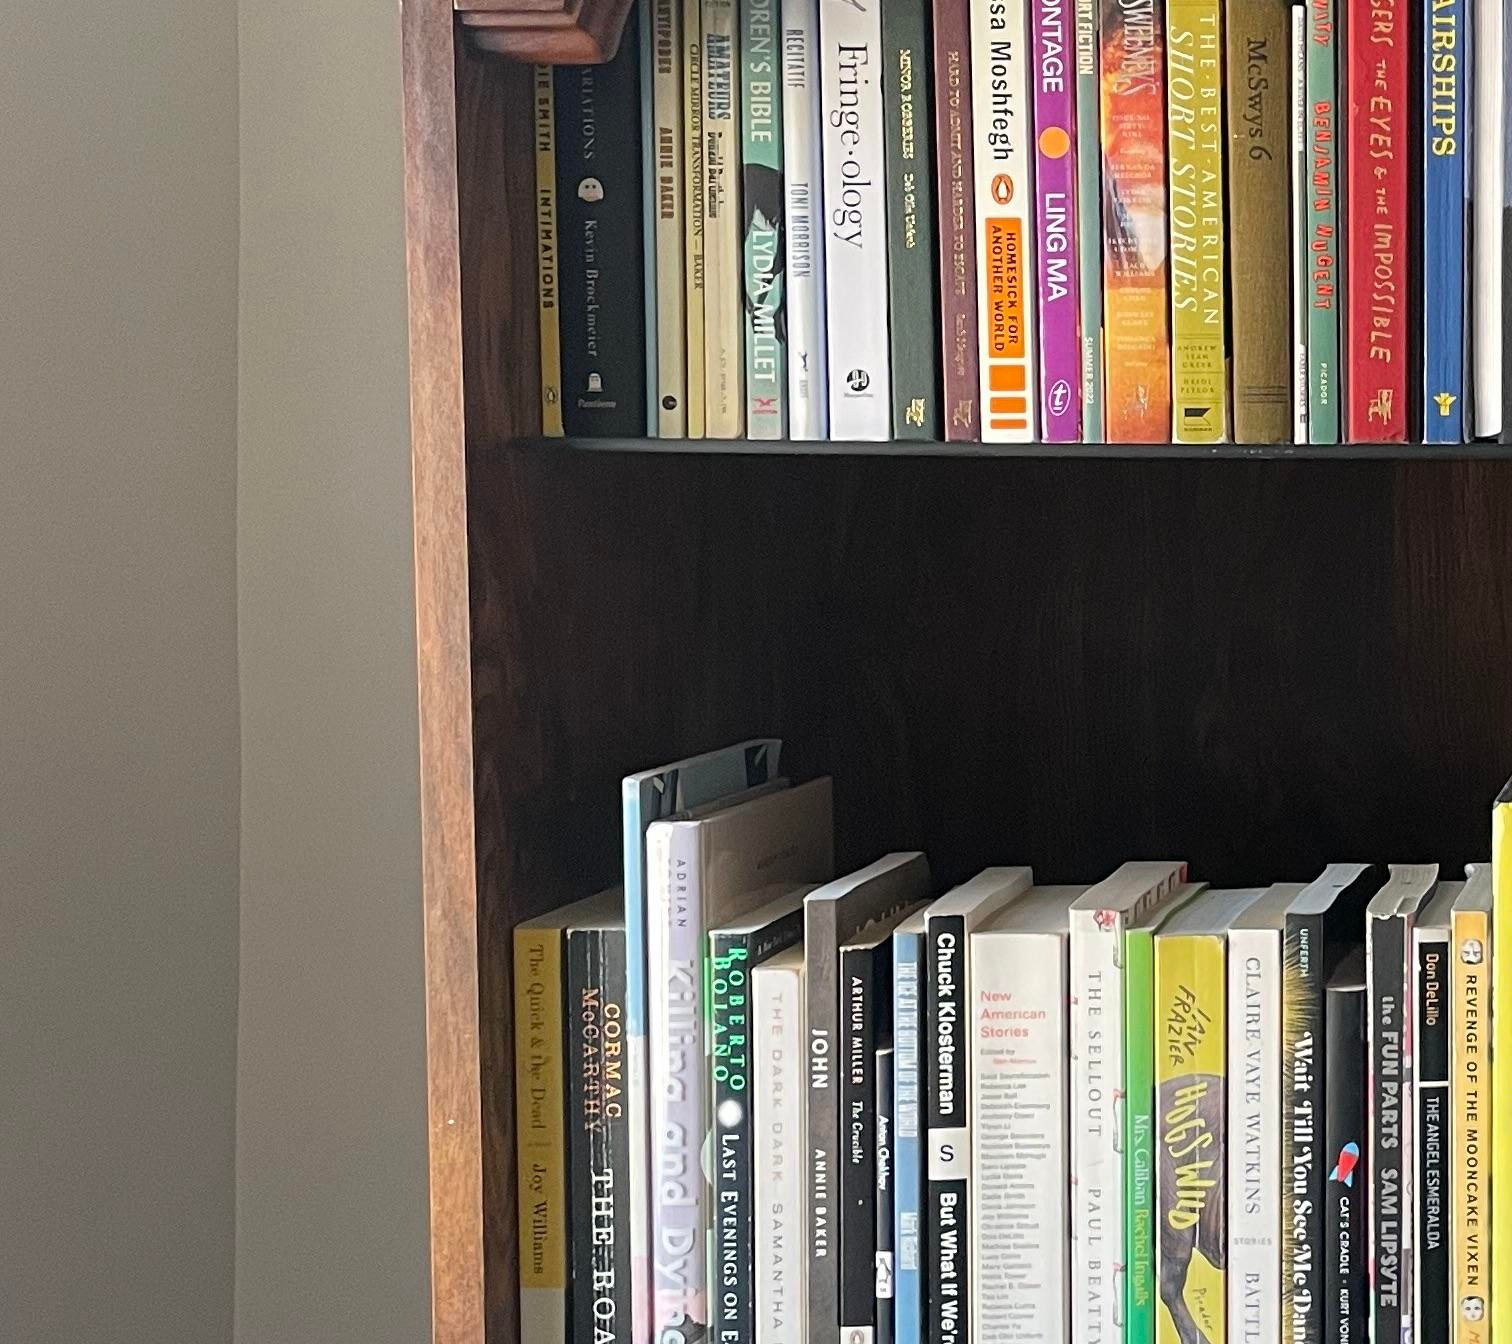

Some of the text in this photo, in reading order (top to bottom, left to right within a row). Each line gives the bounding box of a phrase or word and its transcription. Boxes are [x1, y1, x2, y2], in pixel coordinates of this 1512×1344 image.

[989, 40, 1014, 161] Moshfegh
[991, 225, 1008, 353] ANOTHER WORLD
[1005, 231, 1020, 345] HOMESICK FOR
[1044, 192, 1068, 302] LING MA
[810, 1028, 828, 1089] JOHN
[935, 932, 957, 1115] Chuck Klosterman
[591, 1168, 614, 1246] THE
[939, 1192, 958, 1226] But
[939, 1230, 959, 1280] What
[940, 1284, 959, 1297] If
